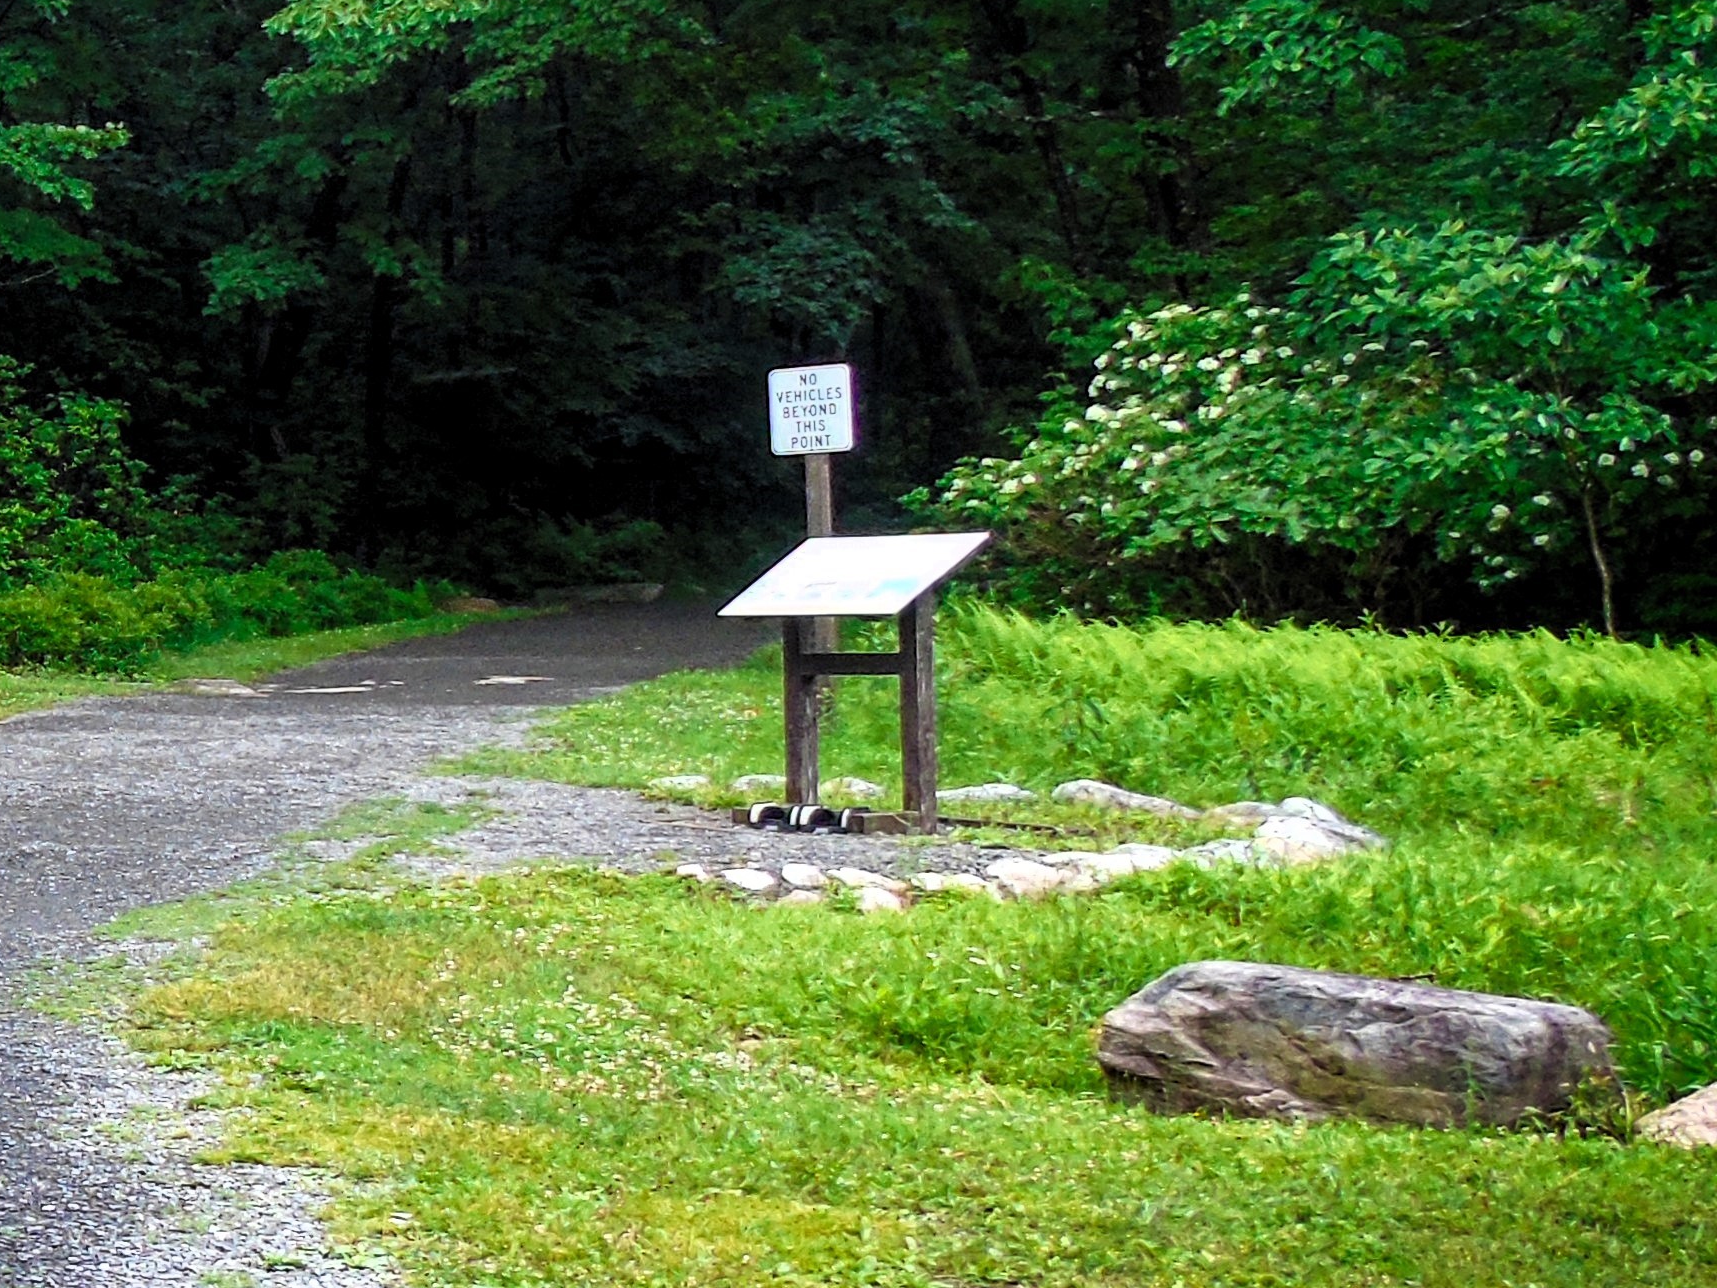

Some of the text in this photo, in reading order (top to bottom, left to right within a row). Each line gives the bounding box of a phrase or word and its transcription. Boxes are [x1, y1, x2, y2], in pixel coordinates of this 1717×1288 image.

[800, 373, 817, 386] NO
[777, 387, 841, 403] VEHICLES
[783, 403, 836, 418] BEYOND
[797, 419, 825, 432] THIS
[791, 435, 831, 448] POINT
